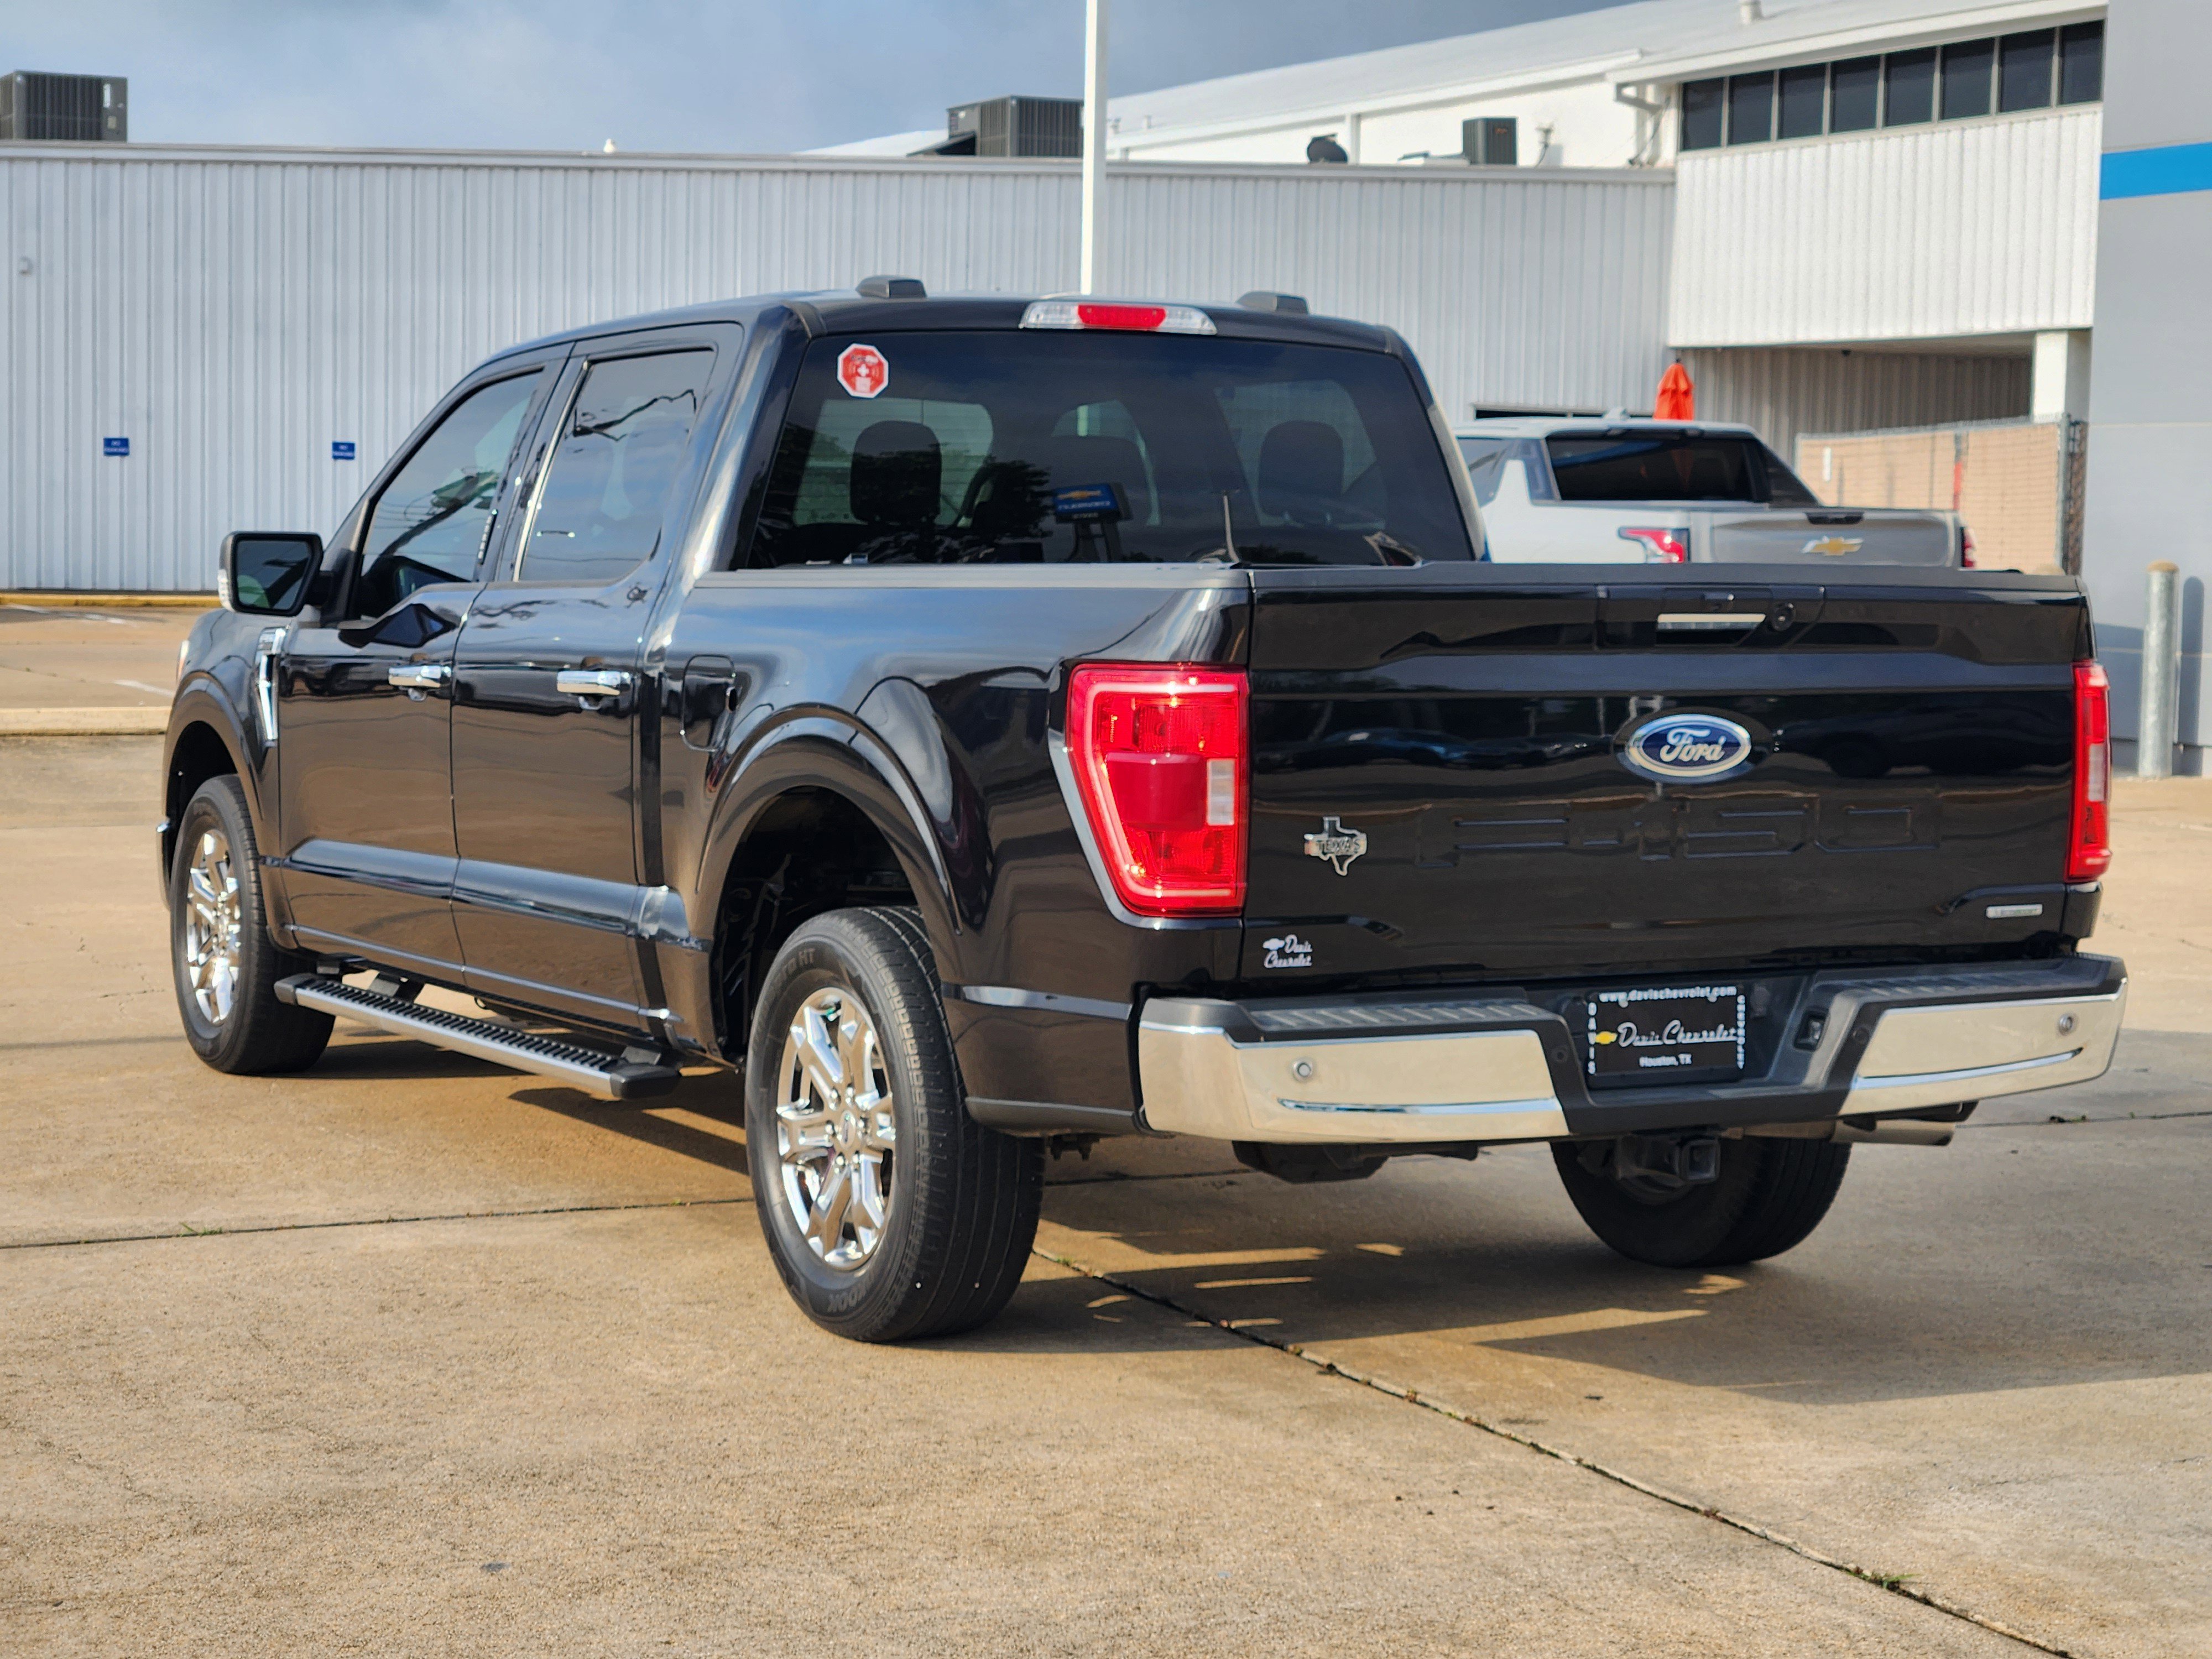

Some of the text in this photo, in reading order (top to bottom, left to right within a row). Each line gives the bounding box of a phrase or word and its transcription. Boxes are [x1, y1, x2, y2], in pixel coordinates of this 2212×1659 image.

[1660, 727, 1726, 761] Ford
[1617, 1019, 1738, 1047] Davis Chevrolet
